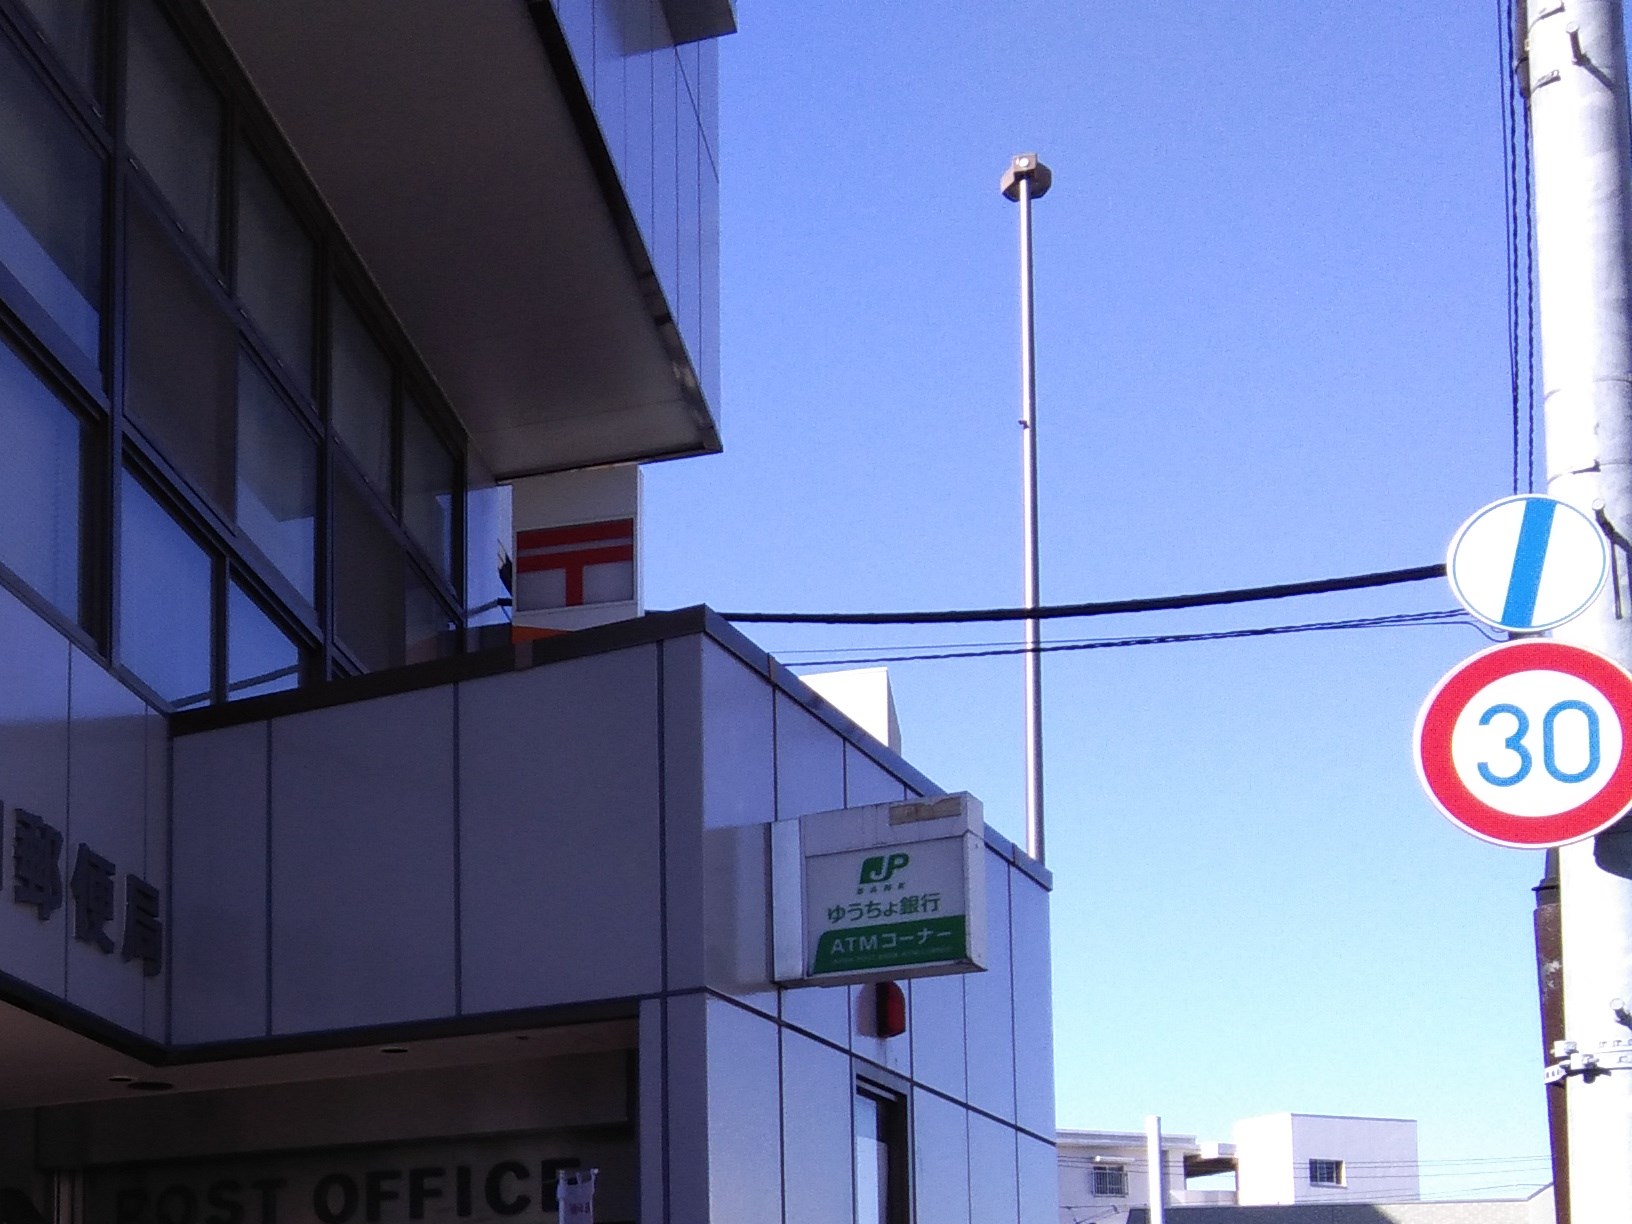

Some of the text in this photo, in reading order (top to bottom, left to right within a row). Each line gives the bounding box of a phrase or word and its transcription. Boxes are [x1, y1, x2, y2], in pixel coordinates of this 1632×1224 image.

[1477, 699, 1601, 788] 30
[860, 853, 909, 884] JP
[828, 893, 941, 924] ゆうちょ銀行
[831, 928, 952, 954] ATMコーナー
